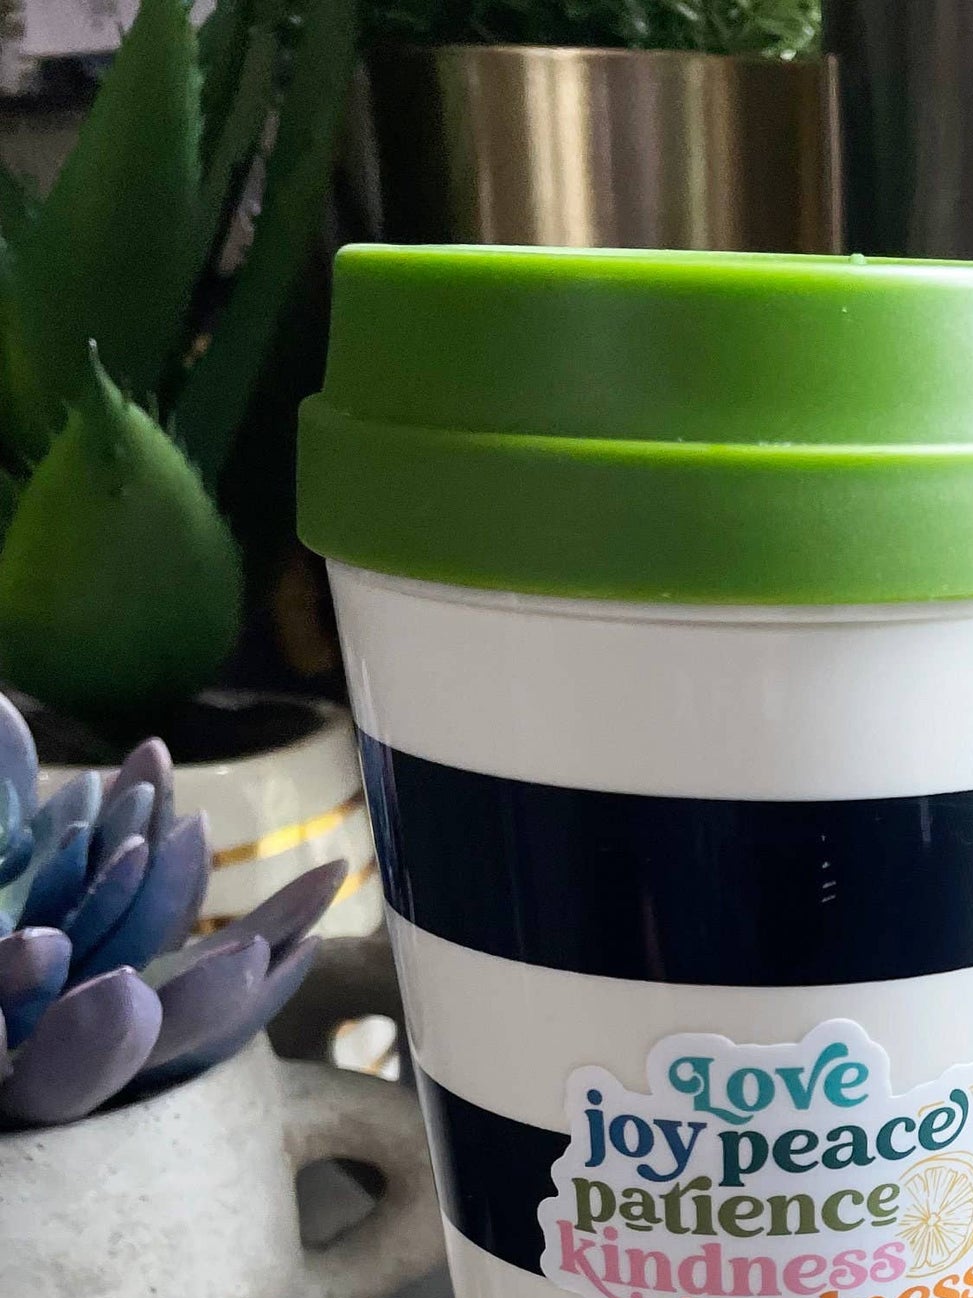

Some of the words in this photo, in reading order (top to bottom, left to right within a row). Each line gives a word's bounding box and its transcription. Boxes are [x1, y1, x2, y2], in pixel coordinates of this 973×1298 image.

[668, 1043, 870, 1125] Love
[584, 1089, 706, 1181] joy
[719, 1088, 969, 1187] peace
[572, 1176, 901, 1237] patience
